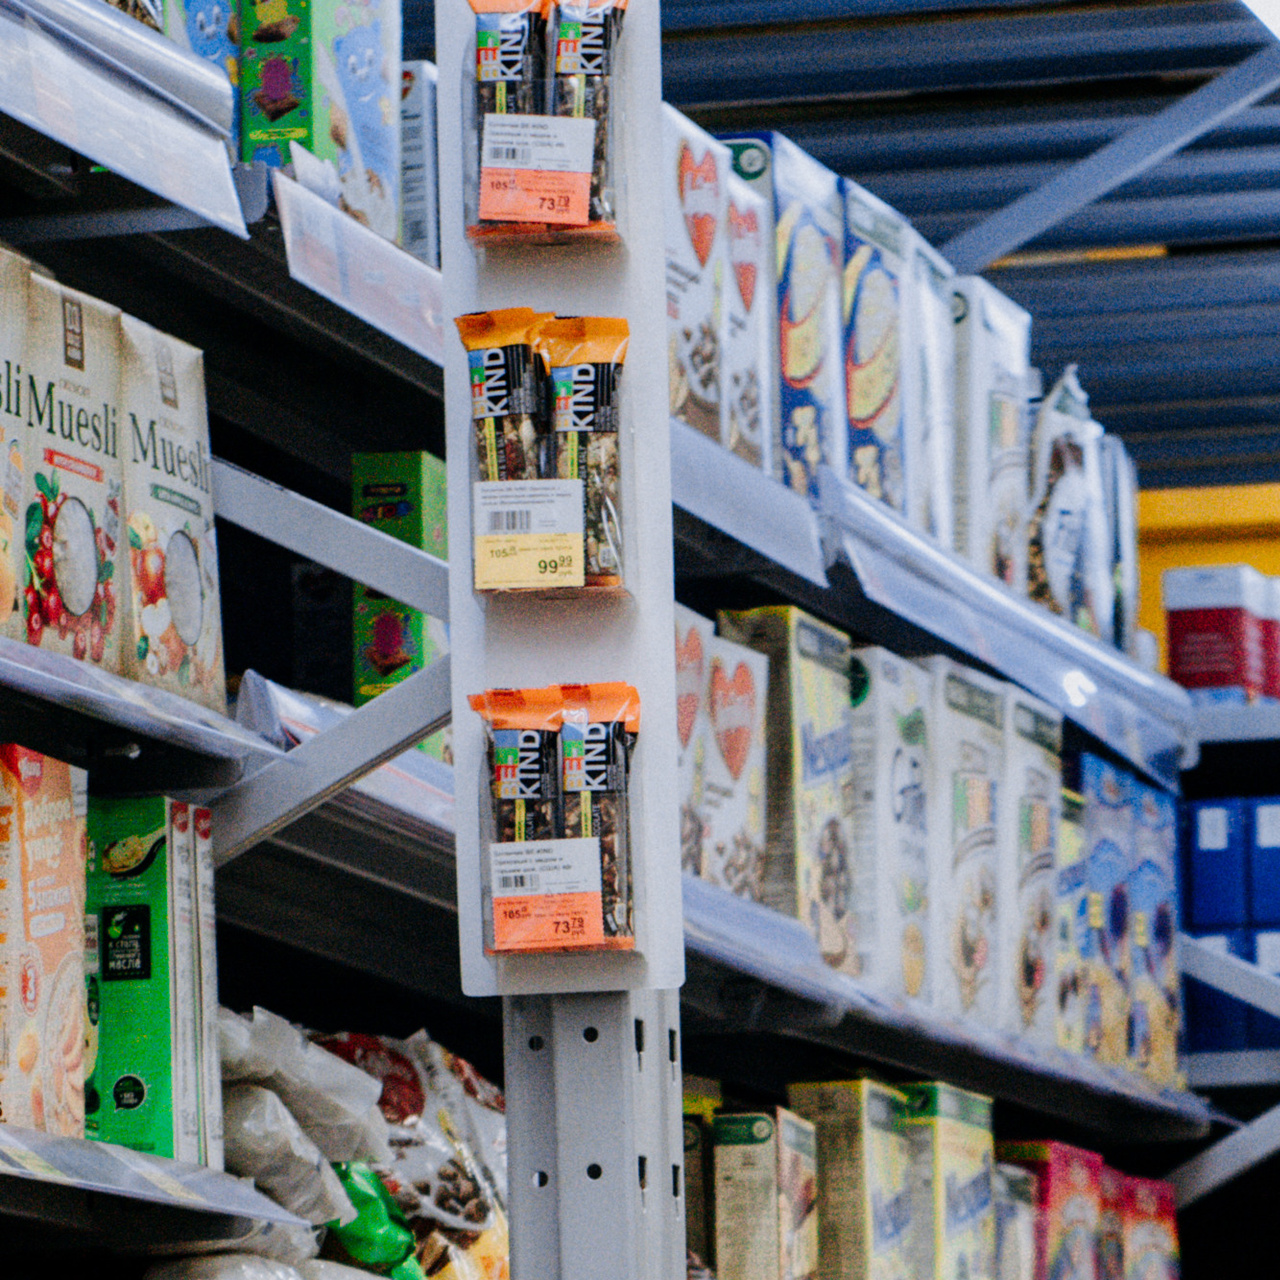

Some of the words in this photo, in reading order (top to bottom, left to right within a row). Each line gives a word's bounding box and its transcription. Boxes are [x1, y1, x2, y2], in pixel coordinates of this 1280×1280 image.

[539, 196, 555, 210] 73
[483, 348, 509, 416] KIND
[572, 363, 596, 431] KIND
[27, 374, 119, 460] Muesli
[129, 412, 211, 494] Muesli
[537, 559, 559, 574] 99
[519, 729, 541, 798] KIND
[585, 722, 607, 790] KIND
[553, 920, 570, 934] 73
